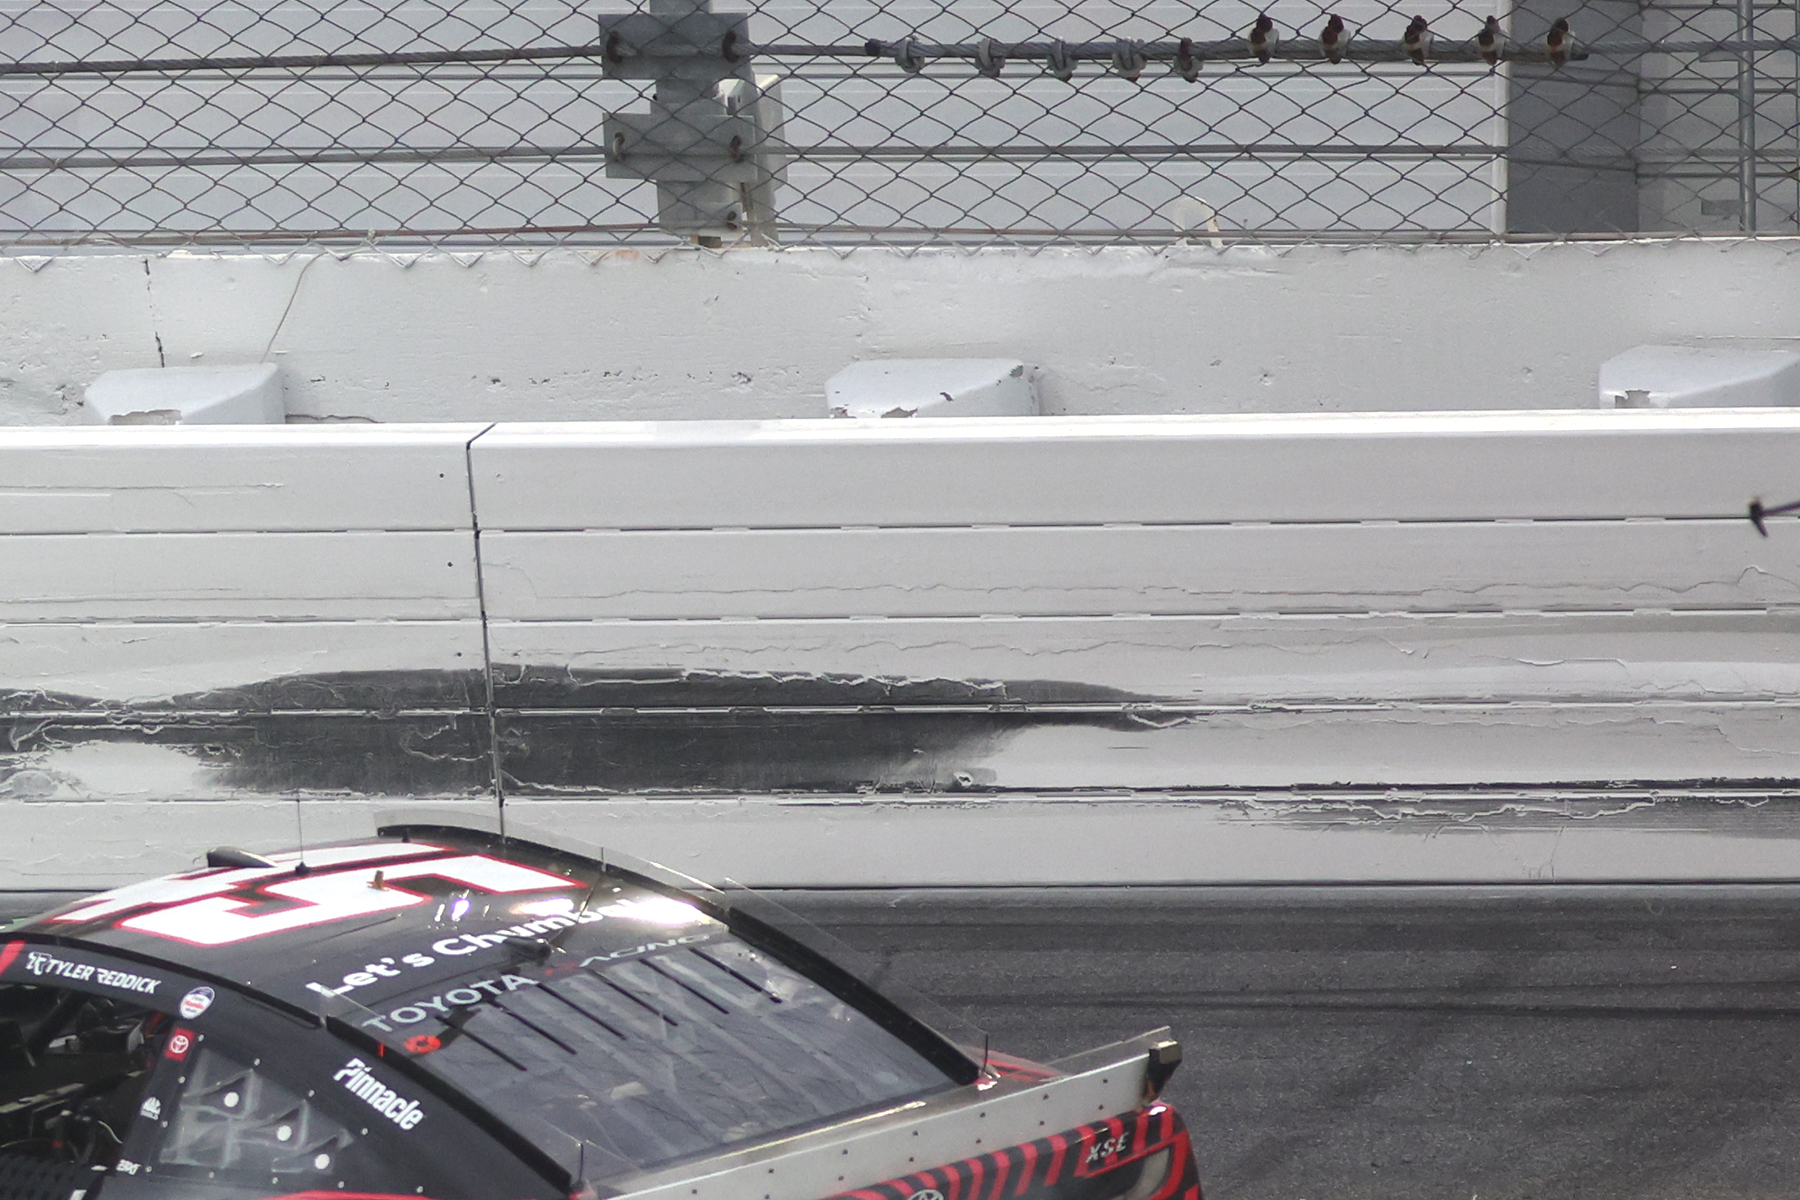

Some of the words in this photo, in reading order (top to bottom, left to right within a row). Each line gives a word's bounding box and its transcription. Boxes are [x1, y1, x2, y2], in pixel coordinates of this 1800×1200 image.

[45, 959, 95, 981] TYLER
[97, 968, 162, 994] REDDICK
[306, 953, 435, 998] Let's
[361, 973, 540, 1033] TOYOTA
[333, 1058, 424, 1131] Pinnacle
